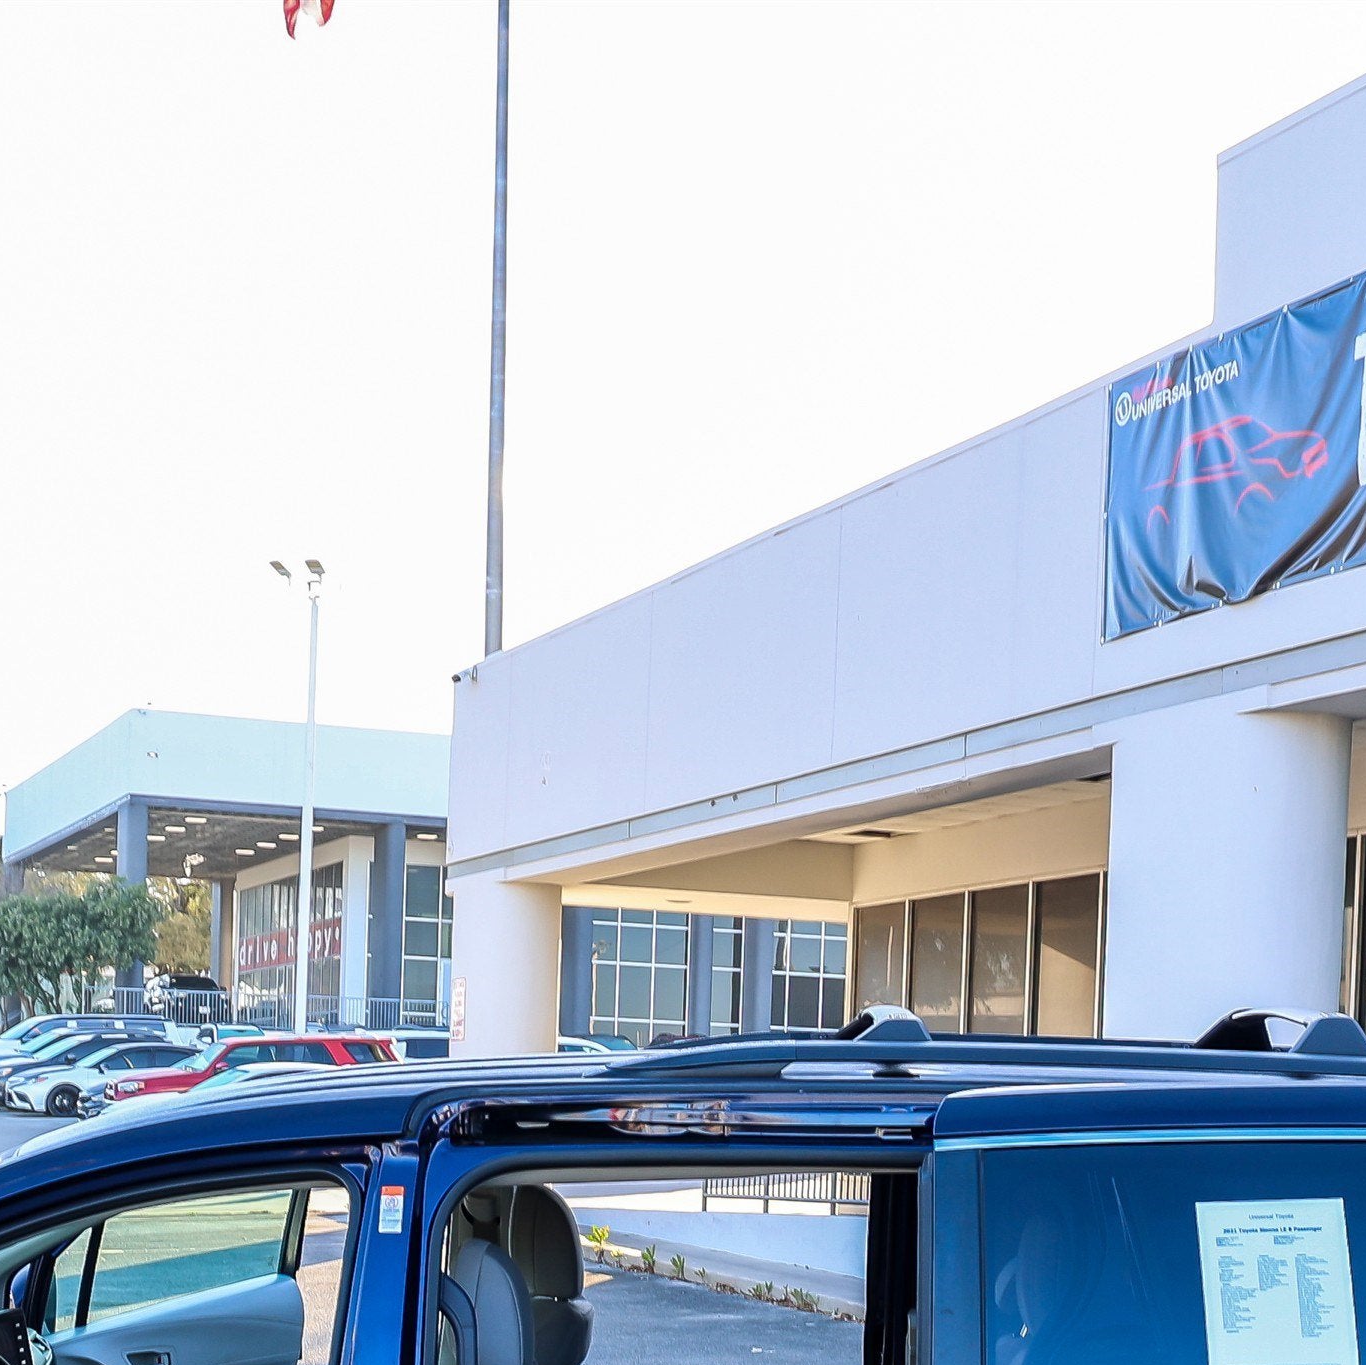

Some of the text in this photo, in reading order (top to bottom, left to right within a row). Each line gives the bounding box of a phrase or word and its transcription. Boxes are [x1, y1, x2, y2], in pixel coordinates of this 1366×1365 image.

[1132, 381, 1192, 421] UNIVERSAL
[1195, 360, 1239, 394] TOYOTA
[240, 936, 277, 966] drive
